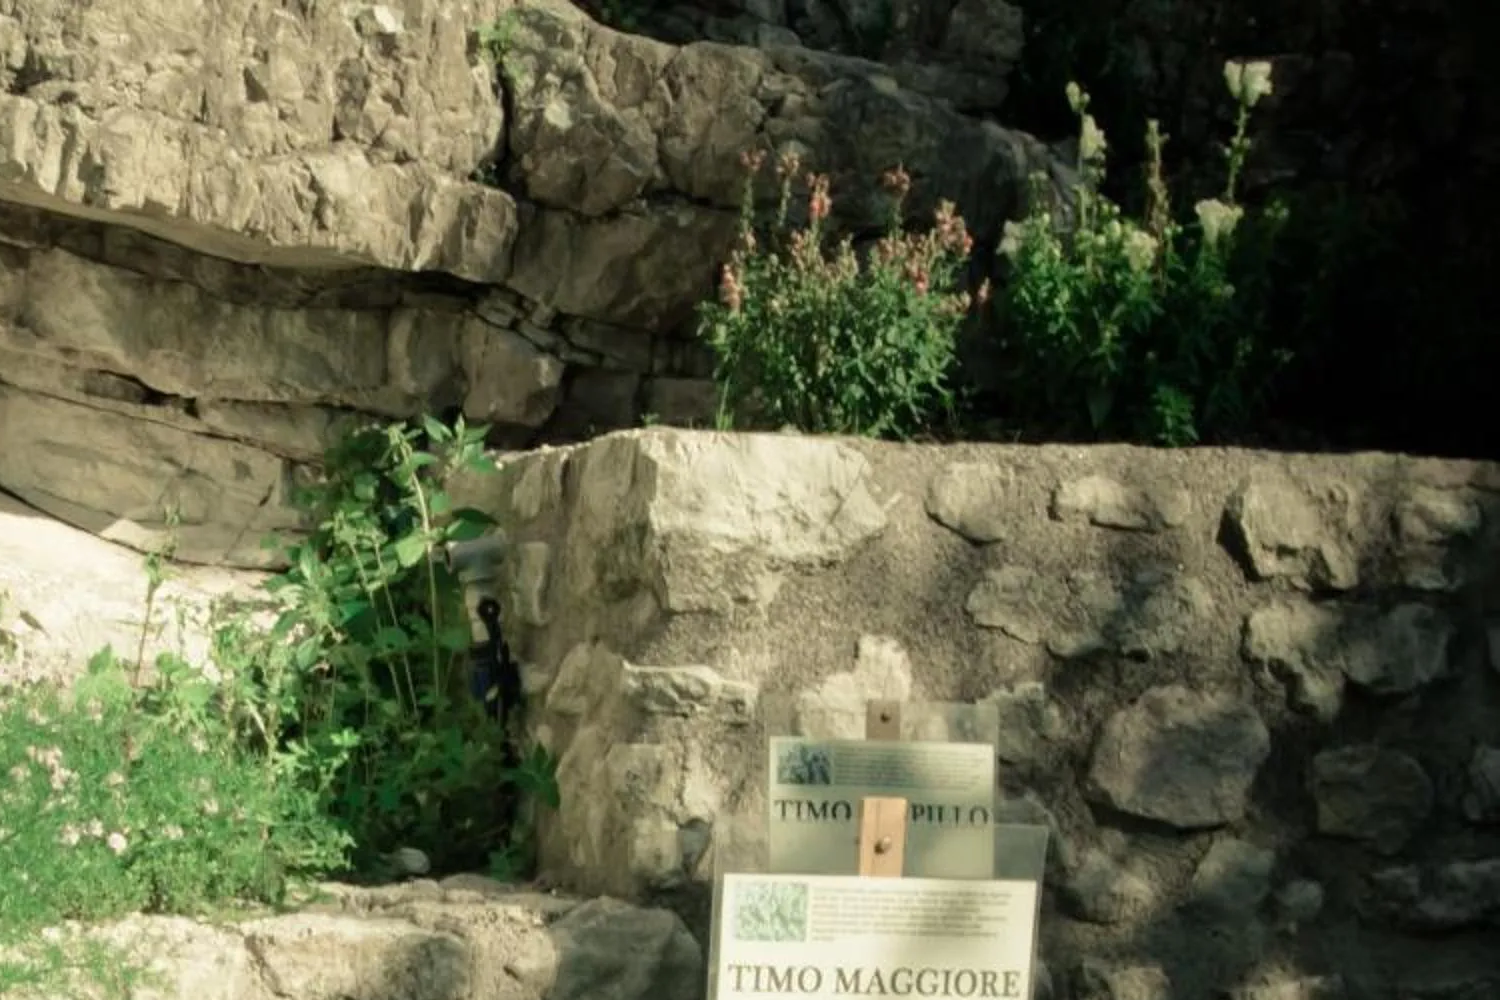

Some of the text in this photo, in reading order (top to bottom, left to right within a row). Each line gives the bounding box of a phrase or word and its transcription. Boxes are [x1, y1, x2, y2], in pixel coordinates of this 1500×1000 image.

[773, 799, 852, 821] TIMO
[728, 964, 1021, 998] TIMO MAGGIORE
